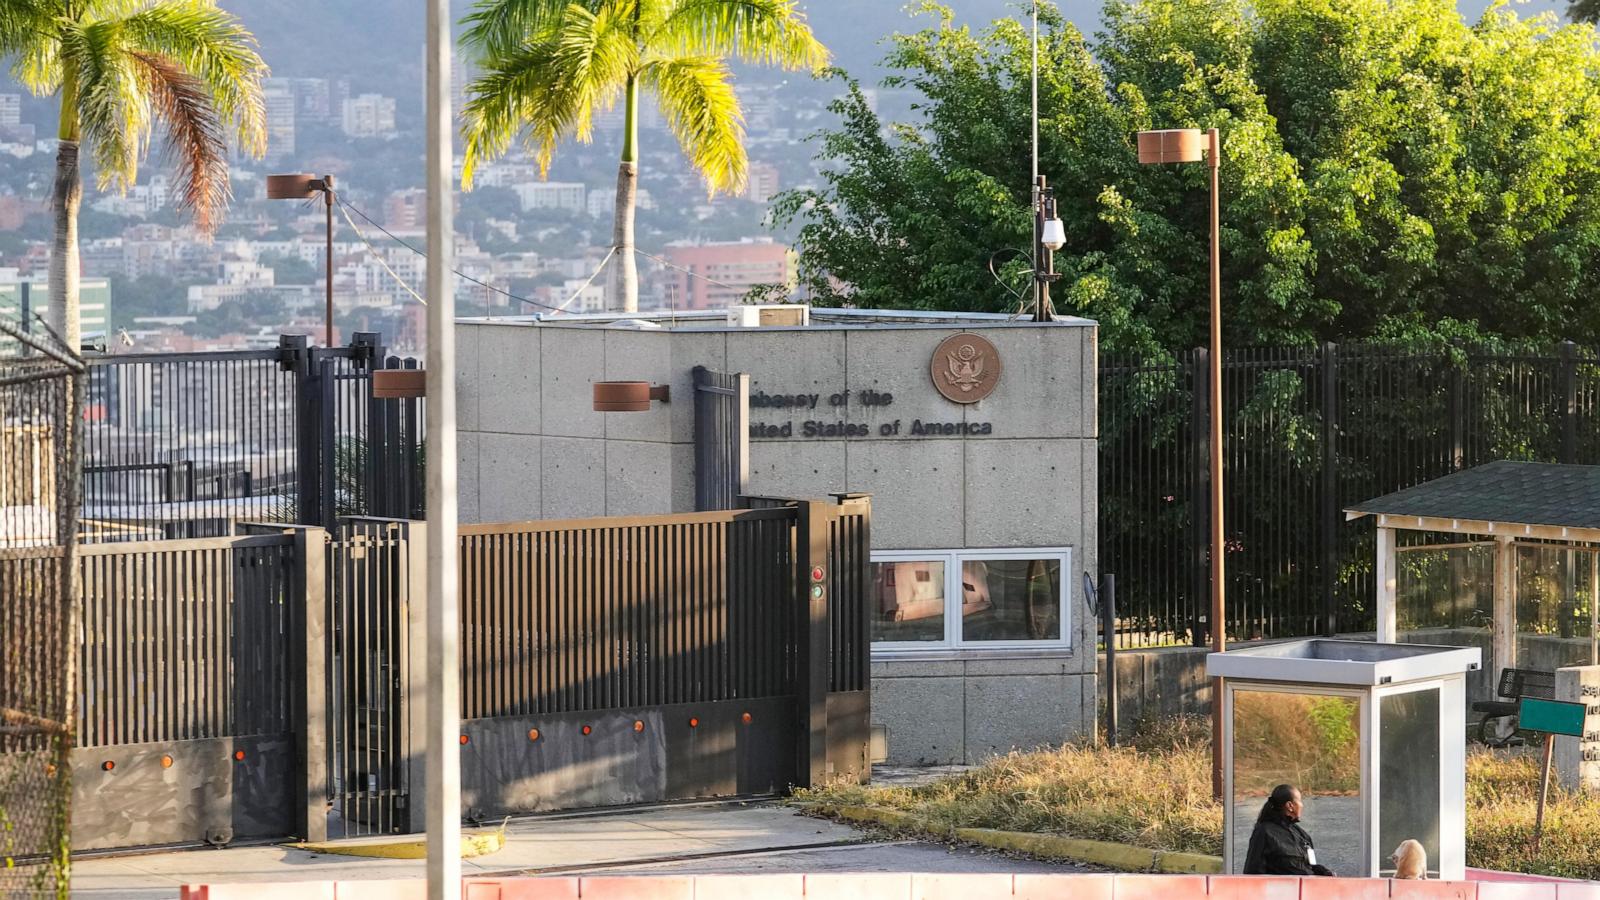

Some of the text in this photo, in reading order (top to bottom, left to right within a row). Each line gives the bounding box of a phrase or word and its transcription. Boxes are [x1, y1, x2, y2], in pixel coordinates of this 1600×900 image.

[829, 389, 850, 406] of
[860, 389, 893, 406] the
[803, 420, 869, 437] States
[880, 419, 901, 436] of
[911, 419, 992, 436] America
